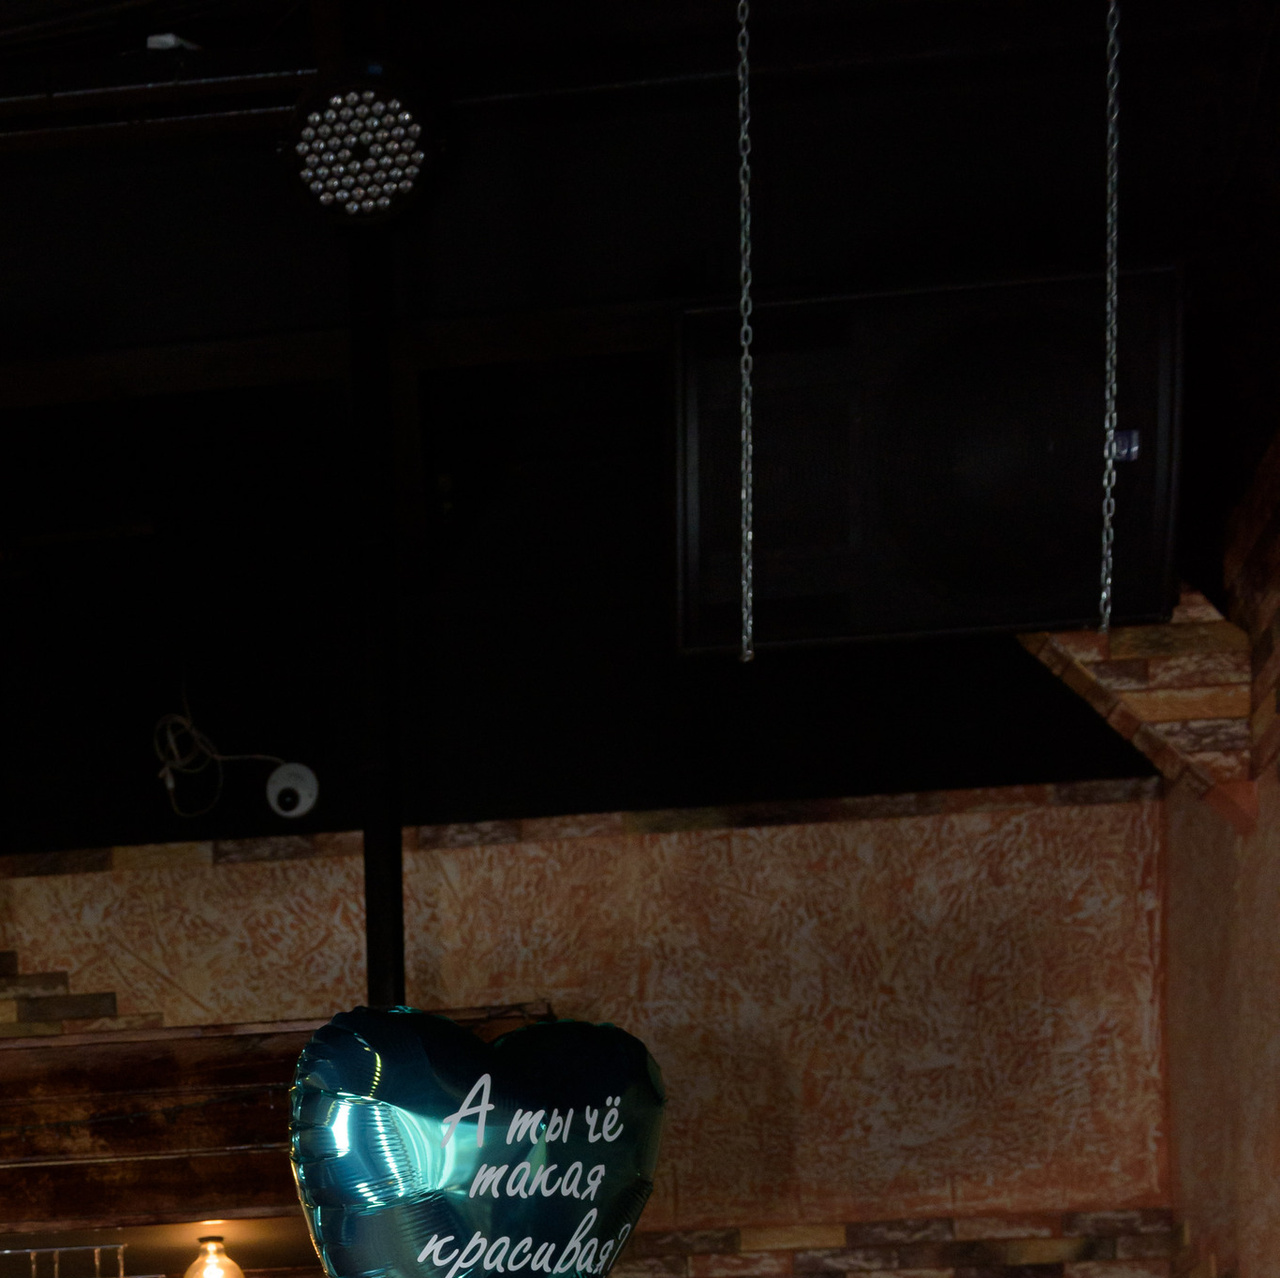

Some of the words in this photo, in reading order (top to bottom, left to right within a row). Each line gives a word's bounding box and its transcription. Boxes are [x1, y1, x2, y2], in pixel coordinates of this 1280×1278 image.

[440, 1073, 495, 1148] А
[506, 1108, 574, 1145] ты
[585, 1096, 624, 1143] чё
[469, 1161, 606, 1201] такая
